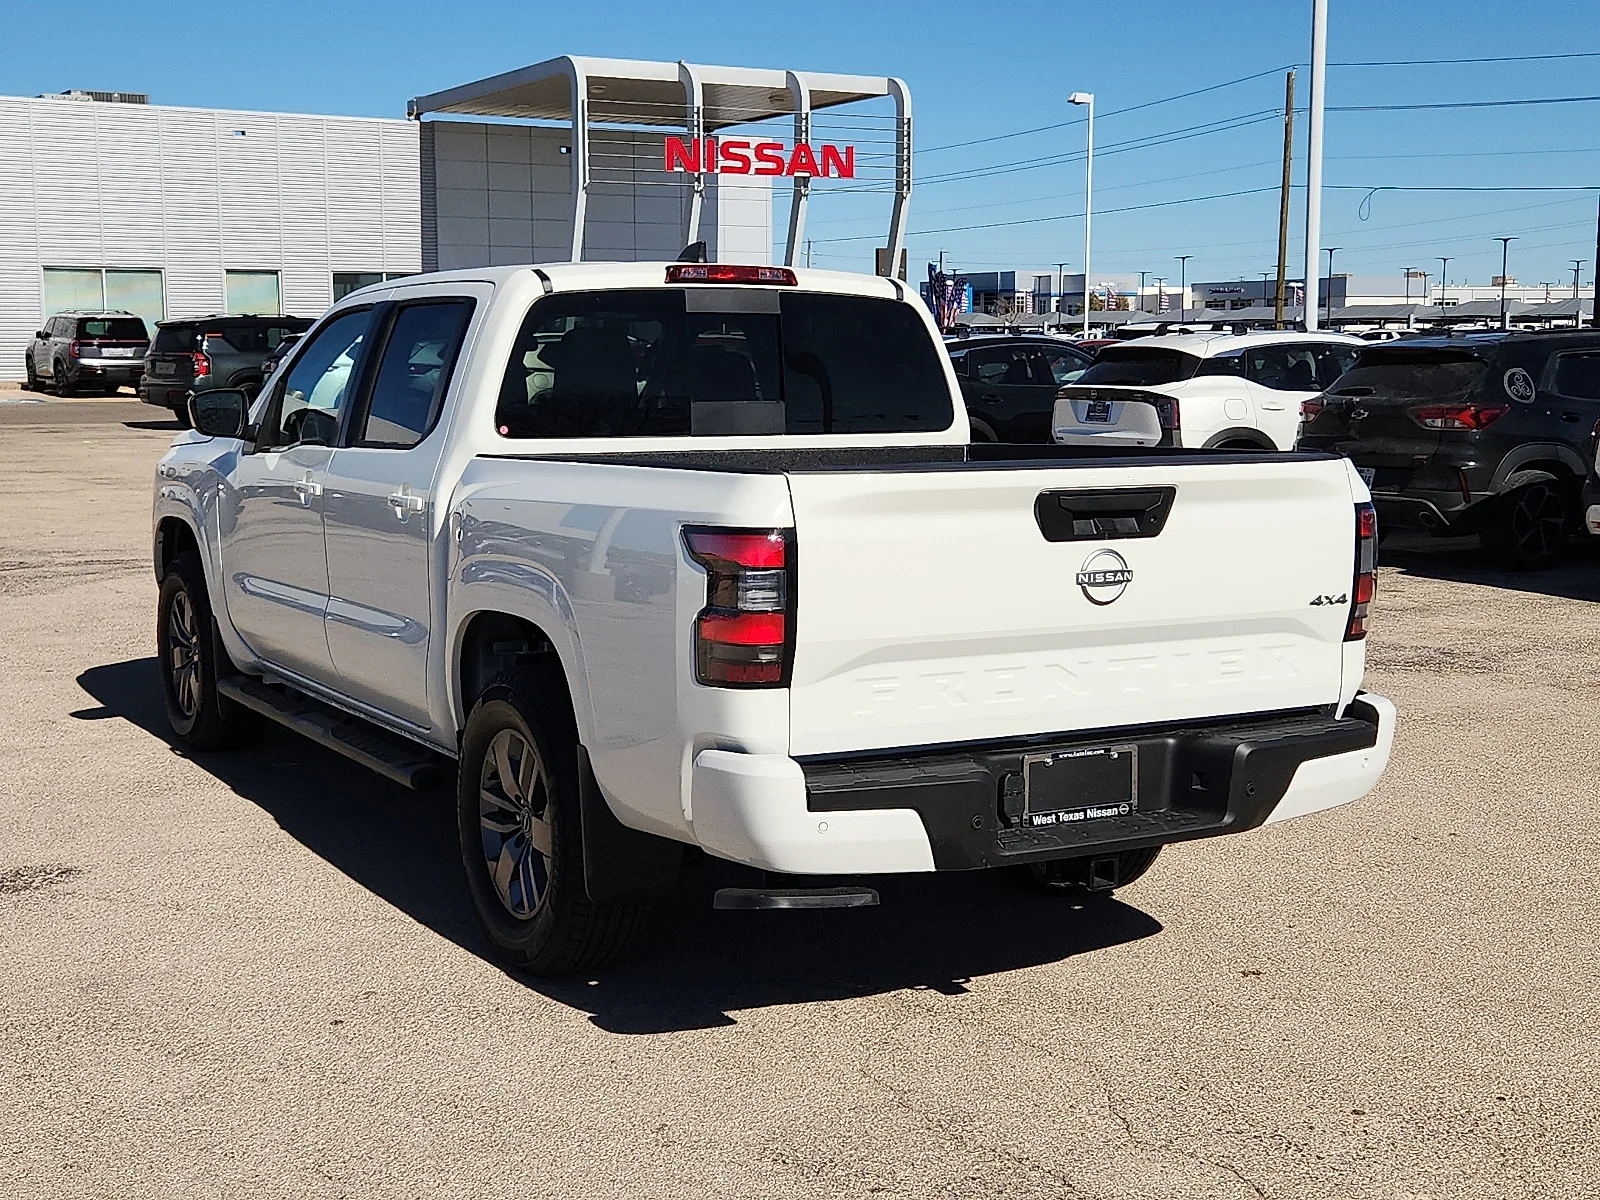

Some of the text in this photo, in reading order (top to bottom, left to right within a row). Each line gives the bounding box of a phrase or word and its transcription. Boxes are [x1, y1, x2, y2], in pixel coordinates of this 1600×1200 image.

[664, 136, 854, 178] NISSAN
[1078, 571, 1132, 583] NISSAN
[852, 643, 1301, 717] FRONTIER
[1032, 807, 1119, 826] West Texas Nissan
